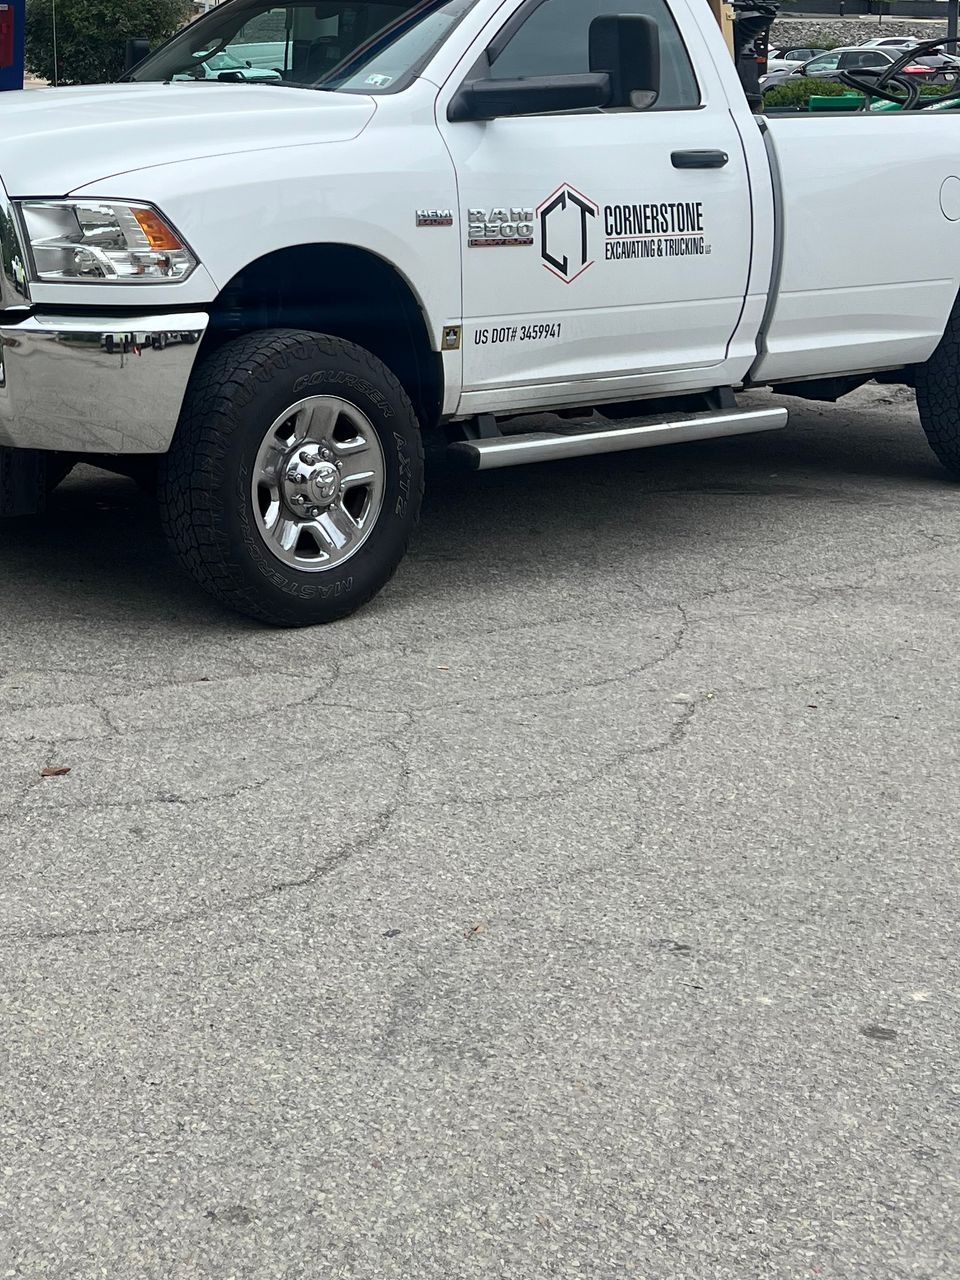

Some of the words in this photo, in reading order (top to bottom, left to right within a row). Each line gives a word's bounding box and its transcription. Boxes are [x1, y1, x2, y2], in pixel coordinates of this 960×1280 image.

[416, 209, 453, 218] HEMI
[468, 207, 534, 223] RAM
[604, 202, 704, 236] CORNERSTONE
[468, 222, 534, 238] 2500
[605, 239, 655, 260] EXCAVATING
[656, 240, 663, 257] &
[664, 237, 704, 257] TRUCKING
[474, 329, 489, 345] US
[491, 326, 518, 344] DOT#
[519, 322, 562, 341] 3459941
[292, 369, 396, 419] COURSER
